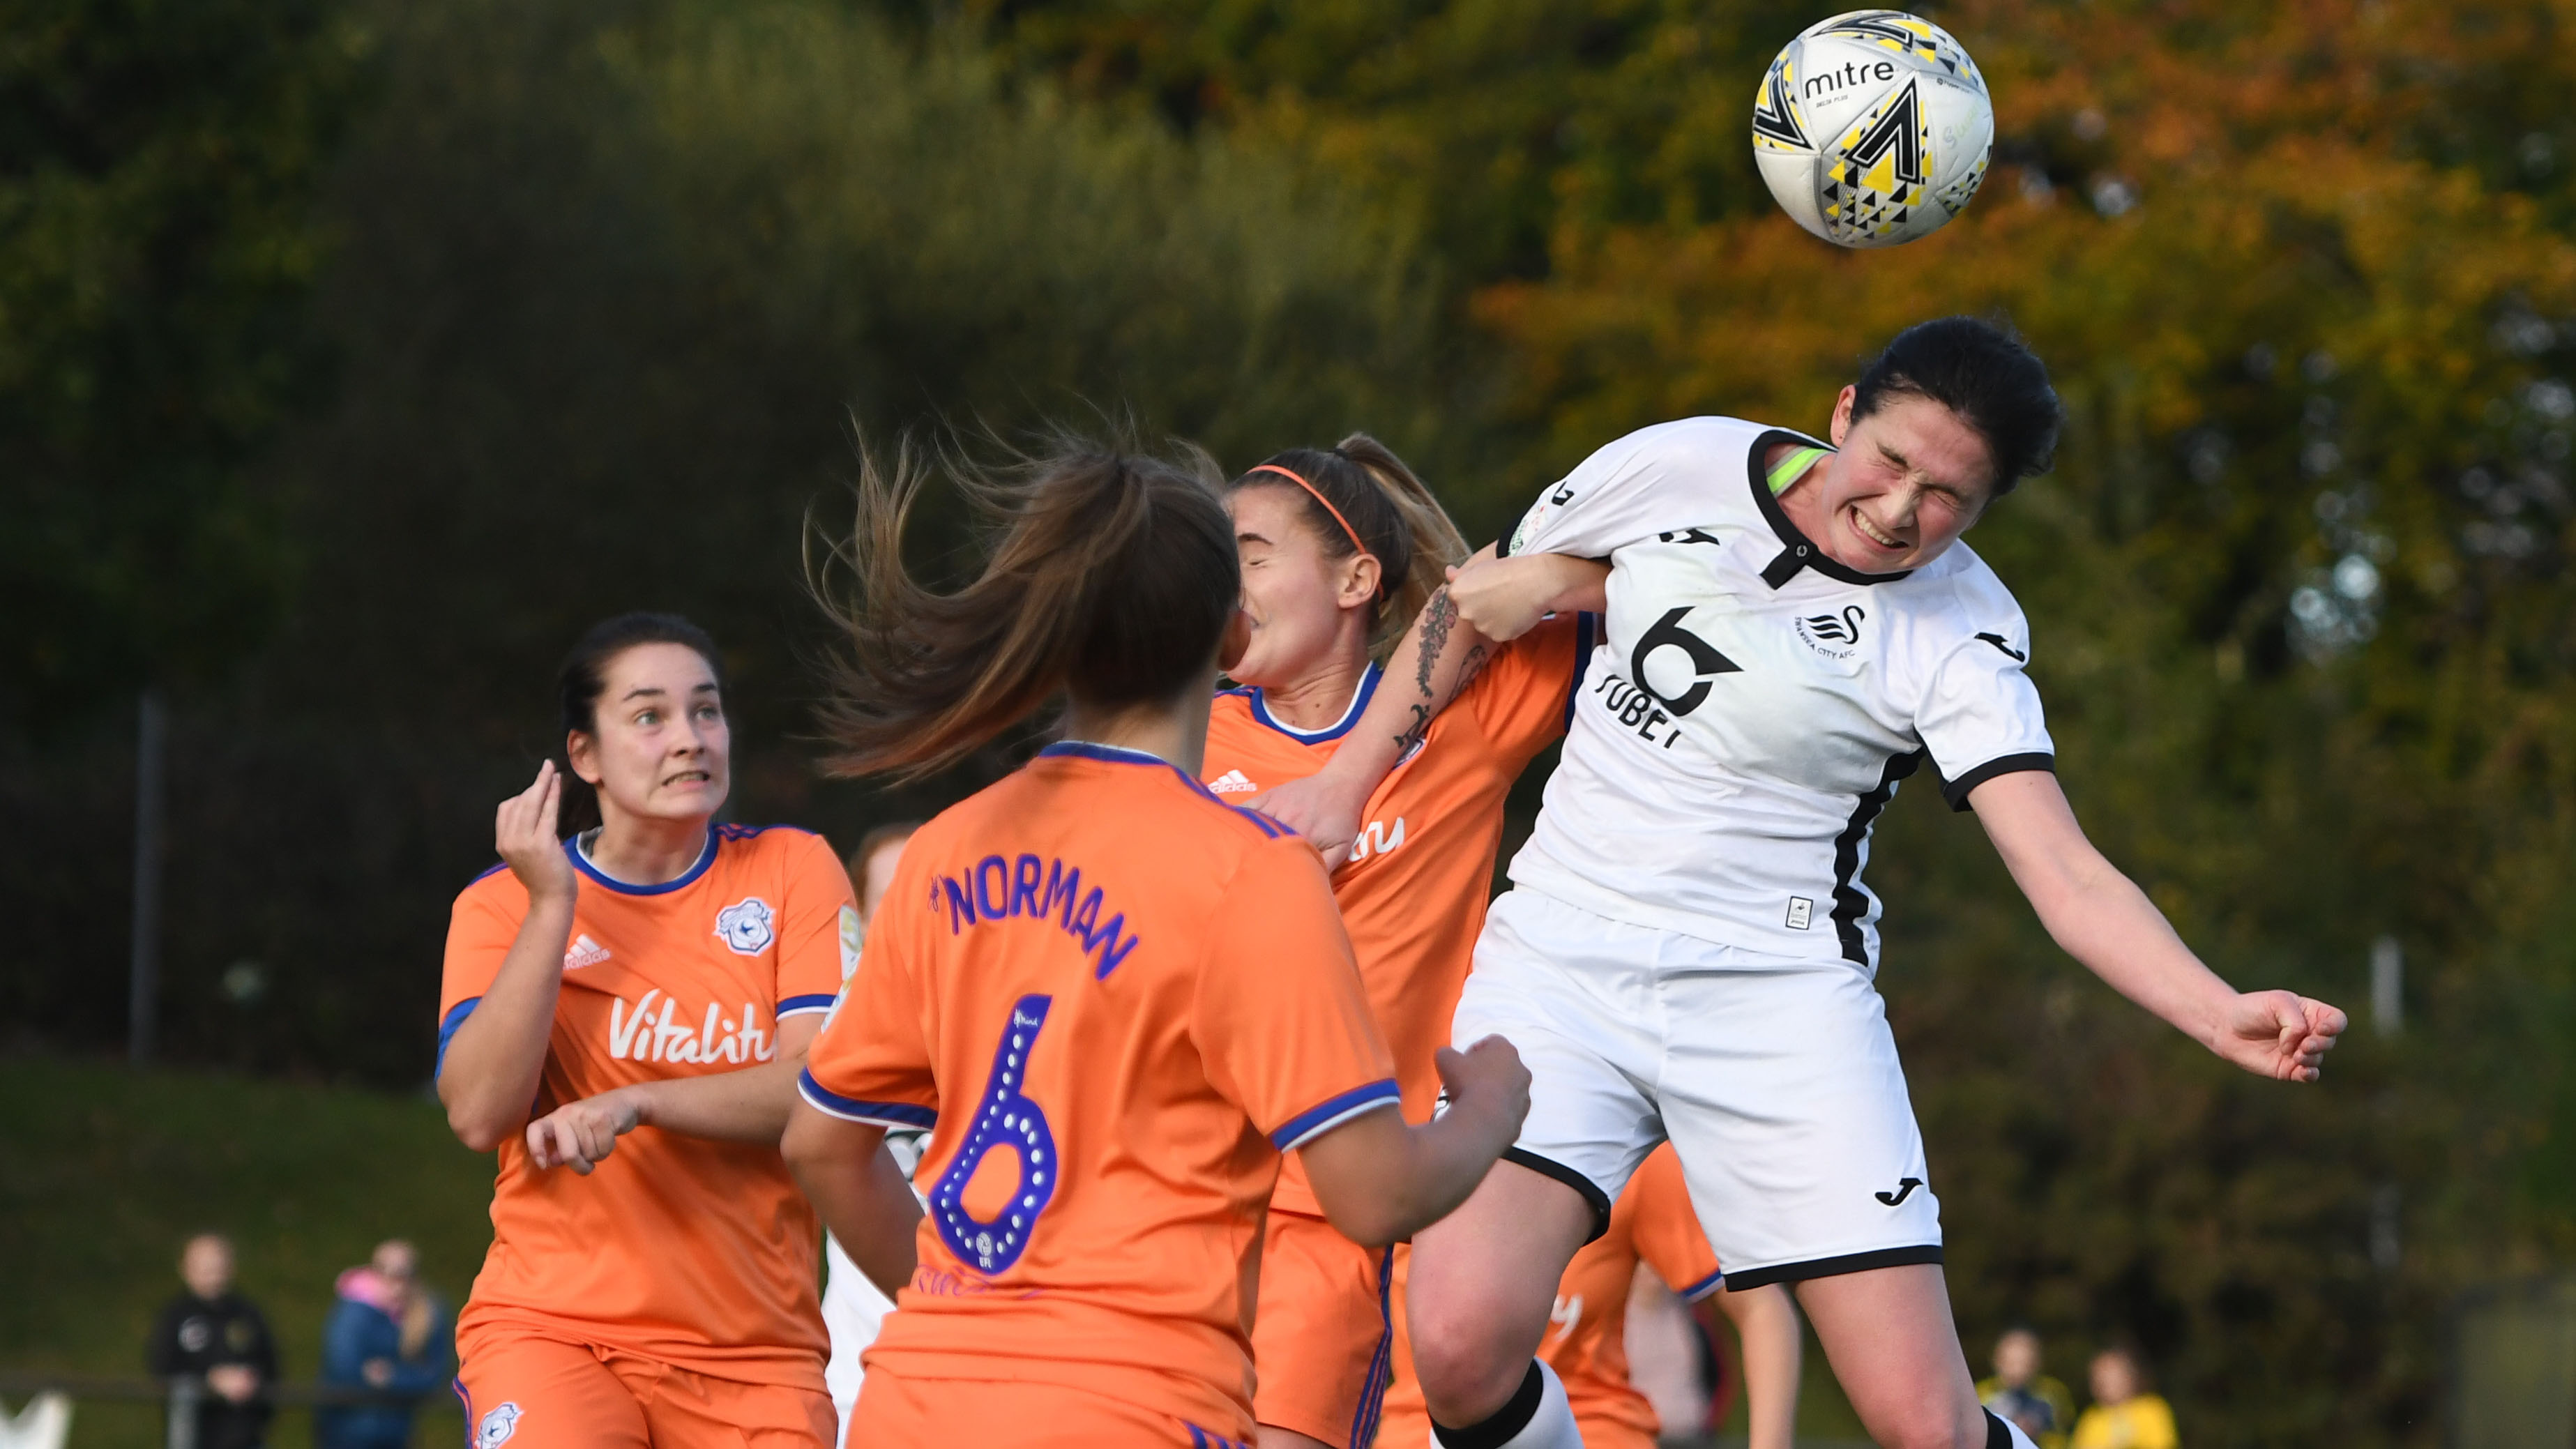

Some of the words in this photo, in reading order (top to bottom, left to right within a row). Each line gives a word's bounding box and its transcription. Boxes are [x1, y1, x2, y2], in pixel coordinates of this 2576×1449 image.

[1805, 62, 1894, 99] mitre
[1817, 647, 1837, 659] CITY
[1839, 649, 1856, 659] AFC
[940, 853, 1138, 981] NORMAN
[928, 994, 1058, 1276] 6
[978, 1256, 992, 1269] EFL
